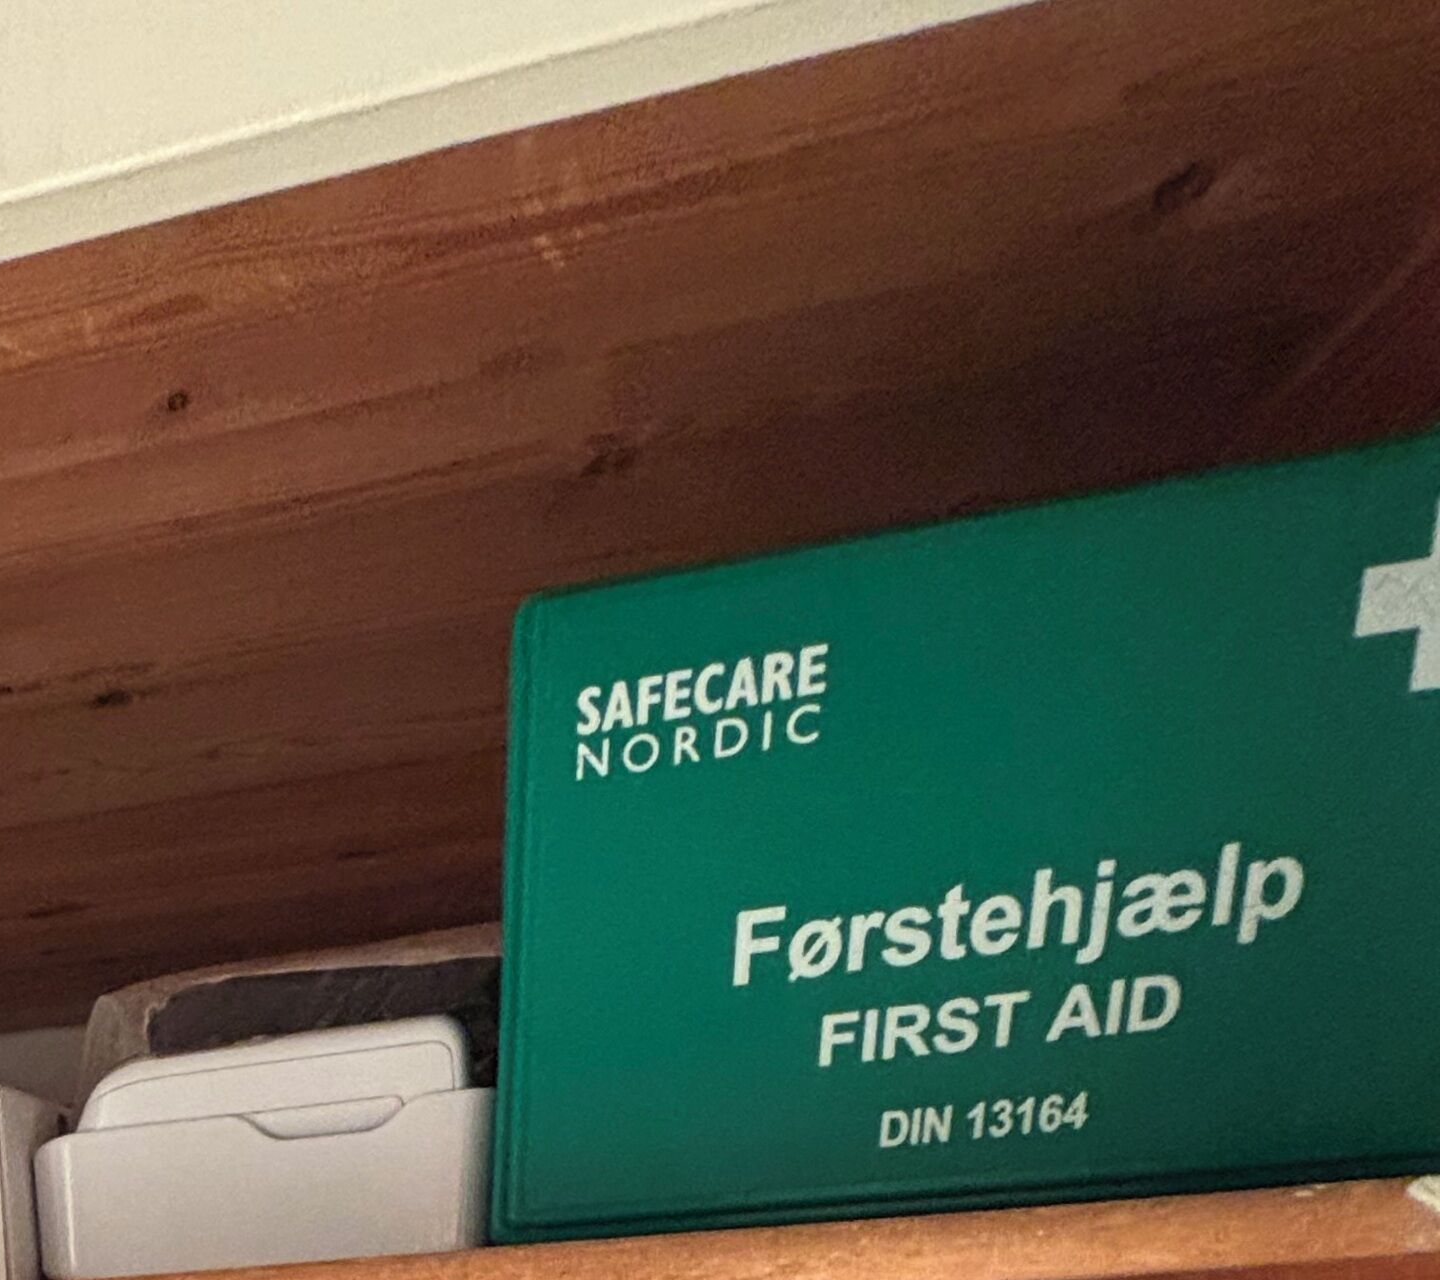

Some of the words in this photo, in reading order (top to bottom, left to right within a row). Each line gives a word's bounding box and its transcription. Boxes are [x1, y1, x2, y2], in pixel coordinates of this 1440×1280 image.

[576, 643, 828, 735] SAFECARE
[575, 703, 821, 781] NORDIC
[732, 841, 1304, 986] Førstehjælp
[818, 990, 1031, 1067] FIRST
[1045, 974, 1181, 1042] AID
[879, 1104, 953, 1148] DIN
[966, 1091, 1089, 1139] 13164
